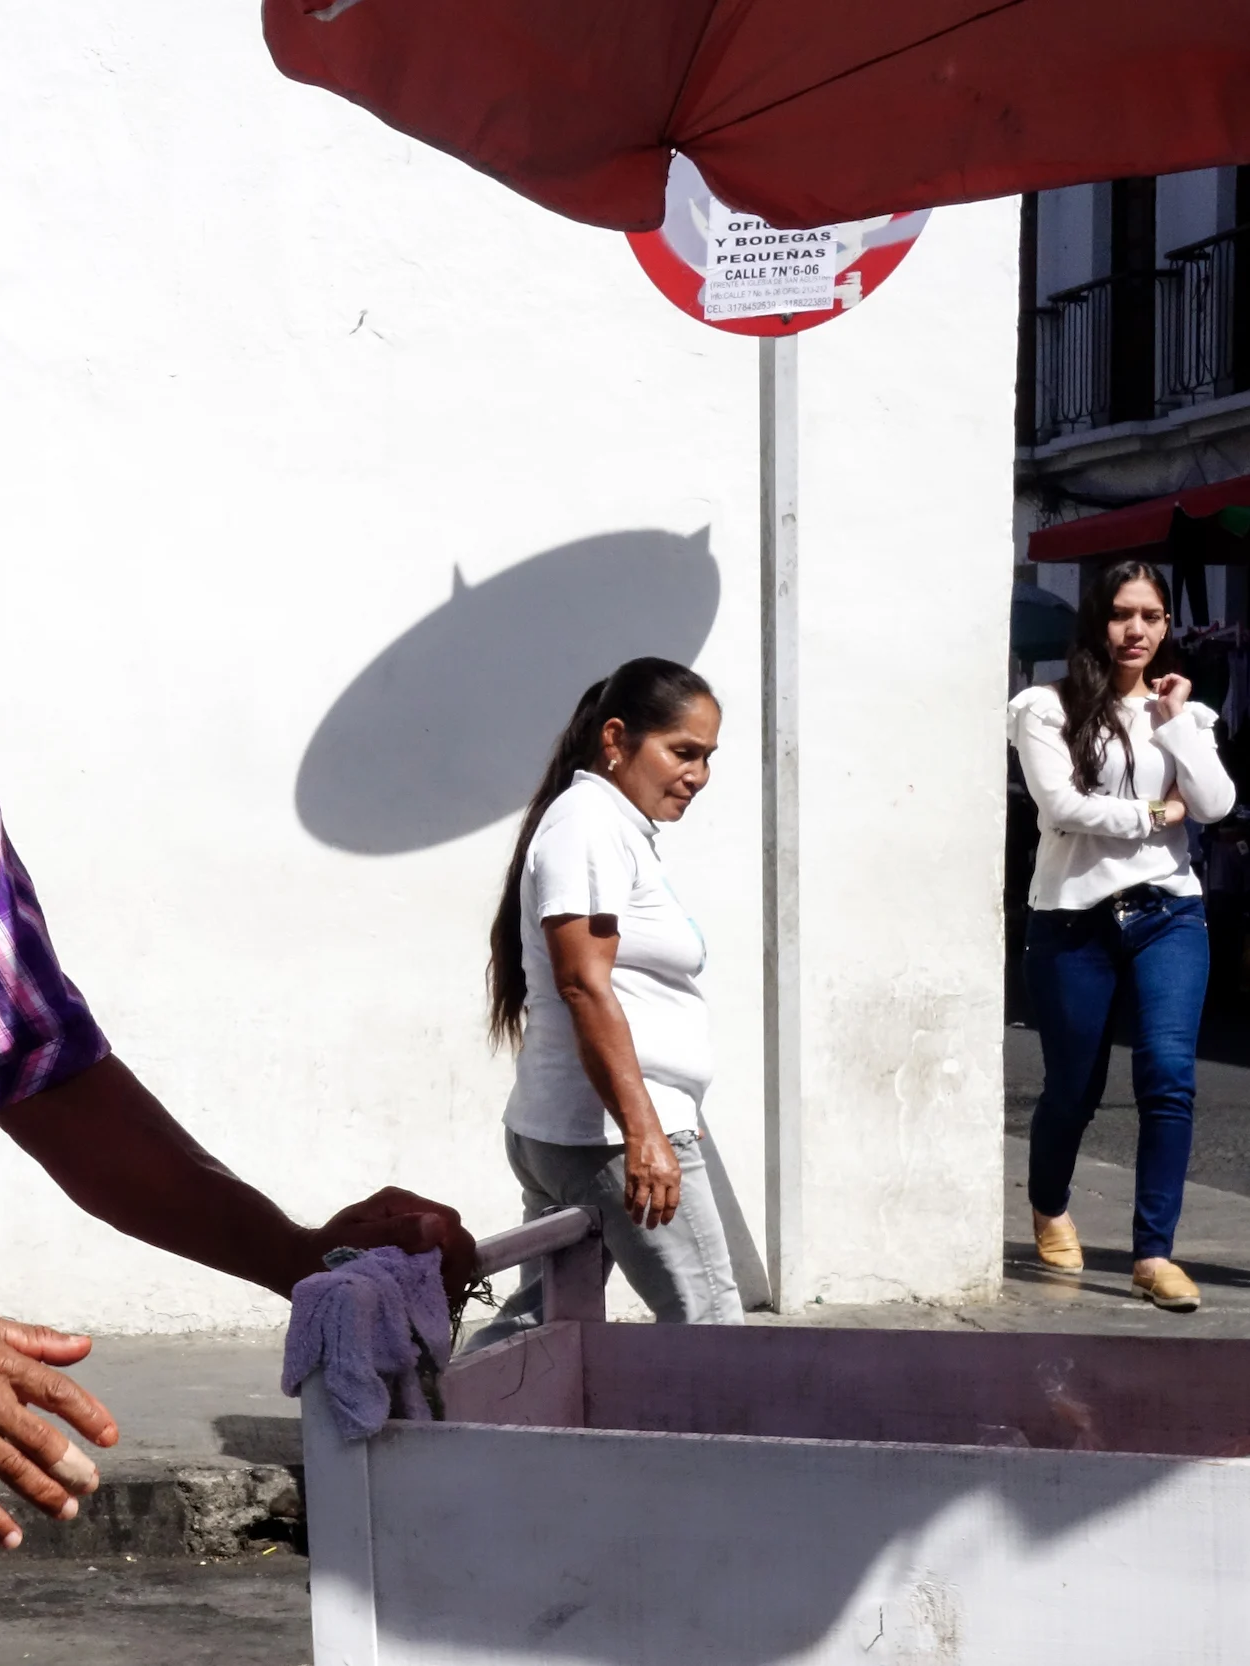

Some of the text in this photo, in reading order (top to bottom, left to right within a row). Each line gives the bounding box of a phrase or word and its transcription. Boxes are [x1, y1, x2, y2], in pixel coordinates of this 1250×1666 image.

[715, 231, 831, 248] Y BODEGAS
[717, 248, 826, 264] PEQUEÑAS
[725, 267, 767, 281] CALLE
